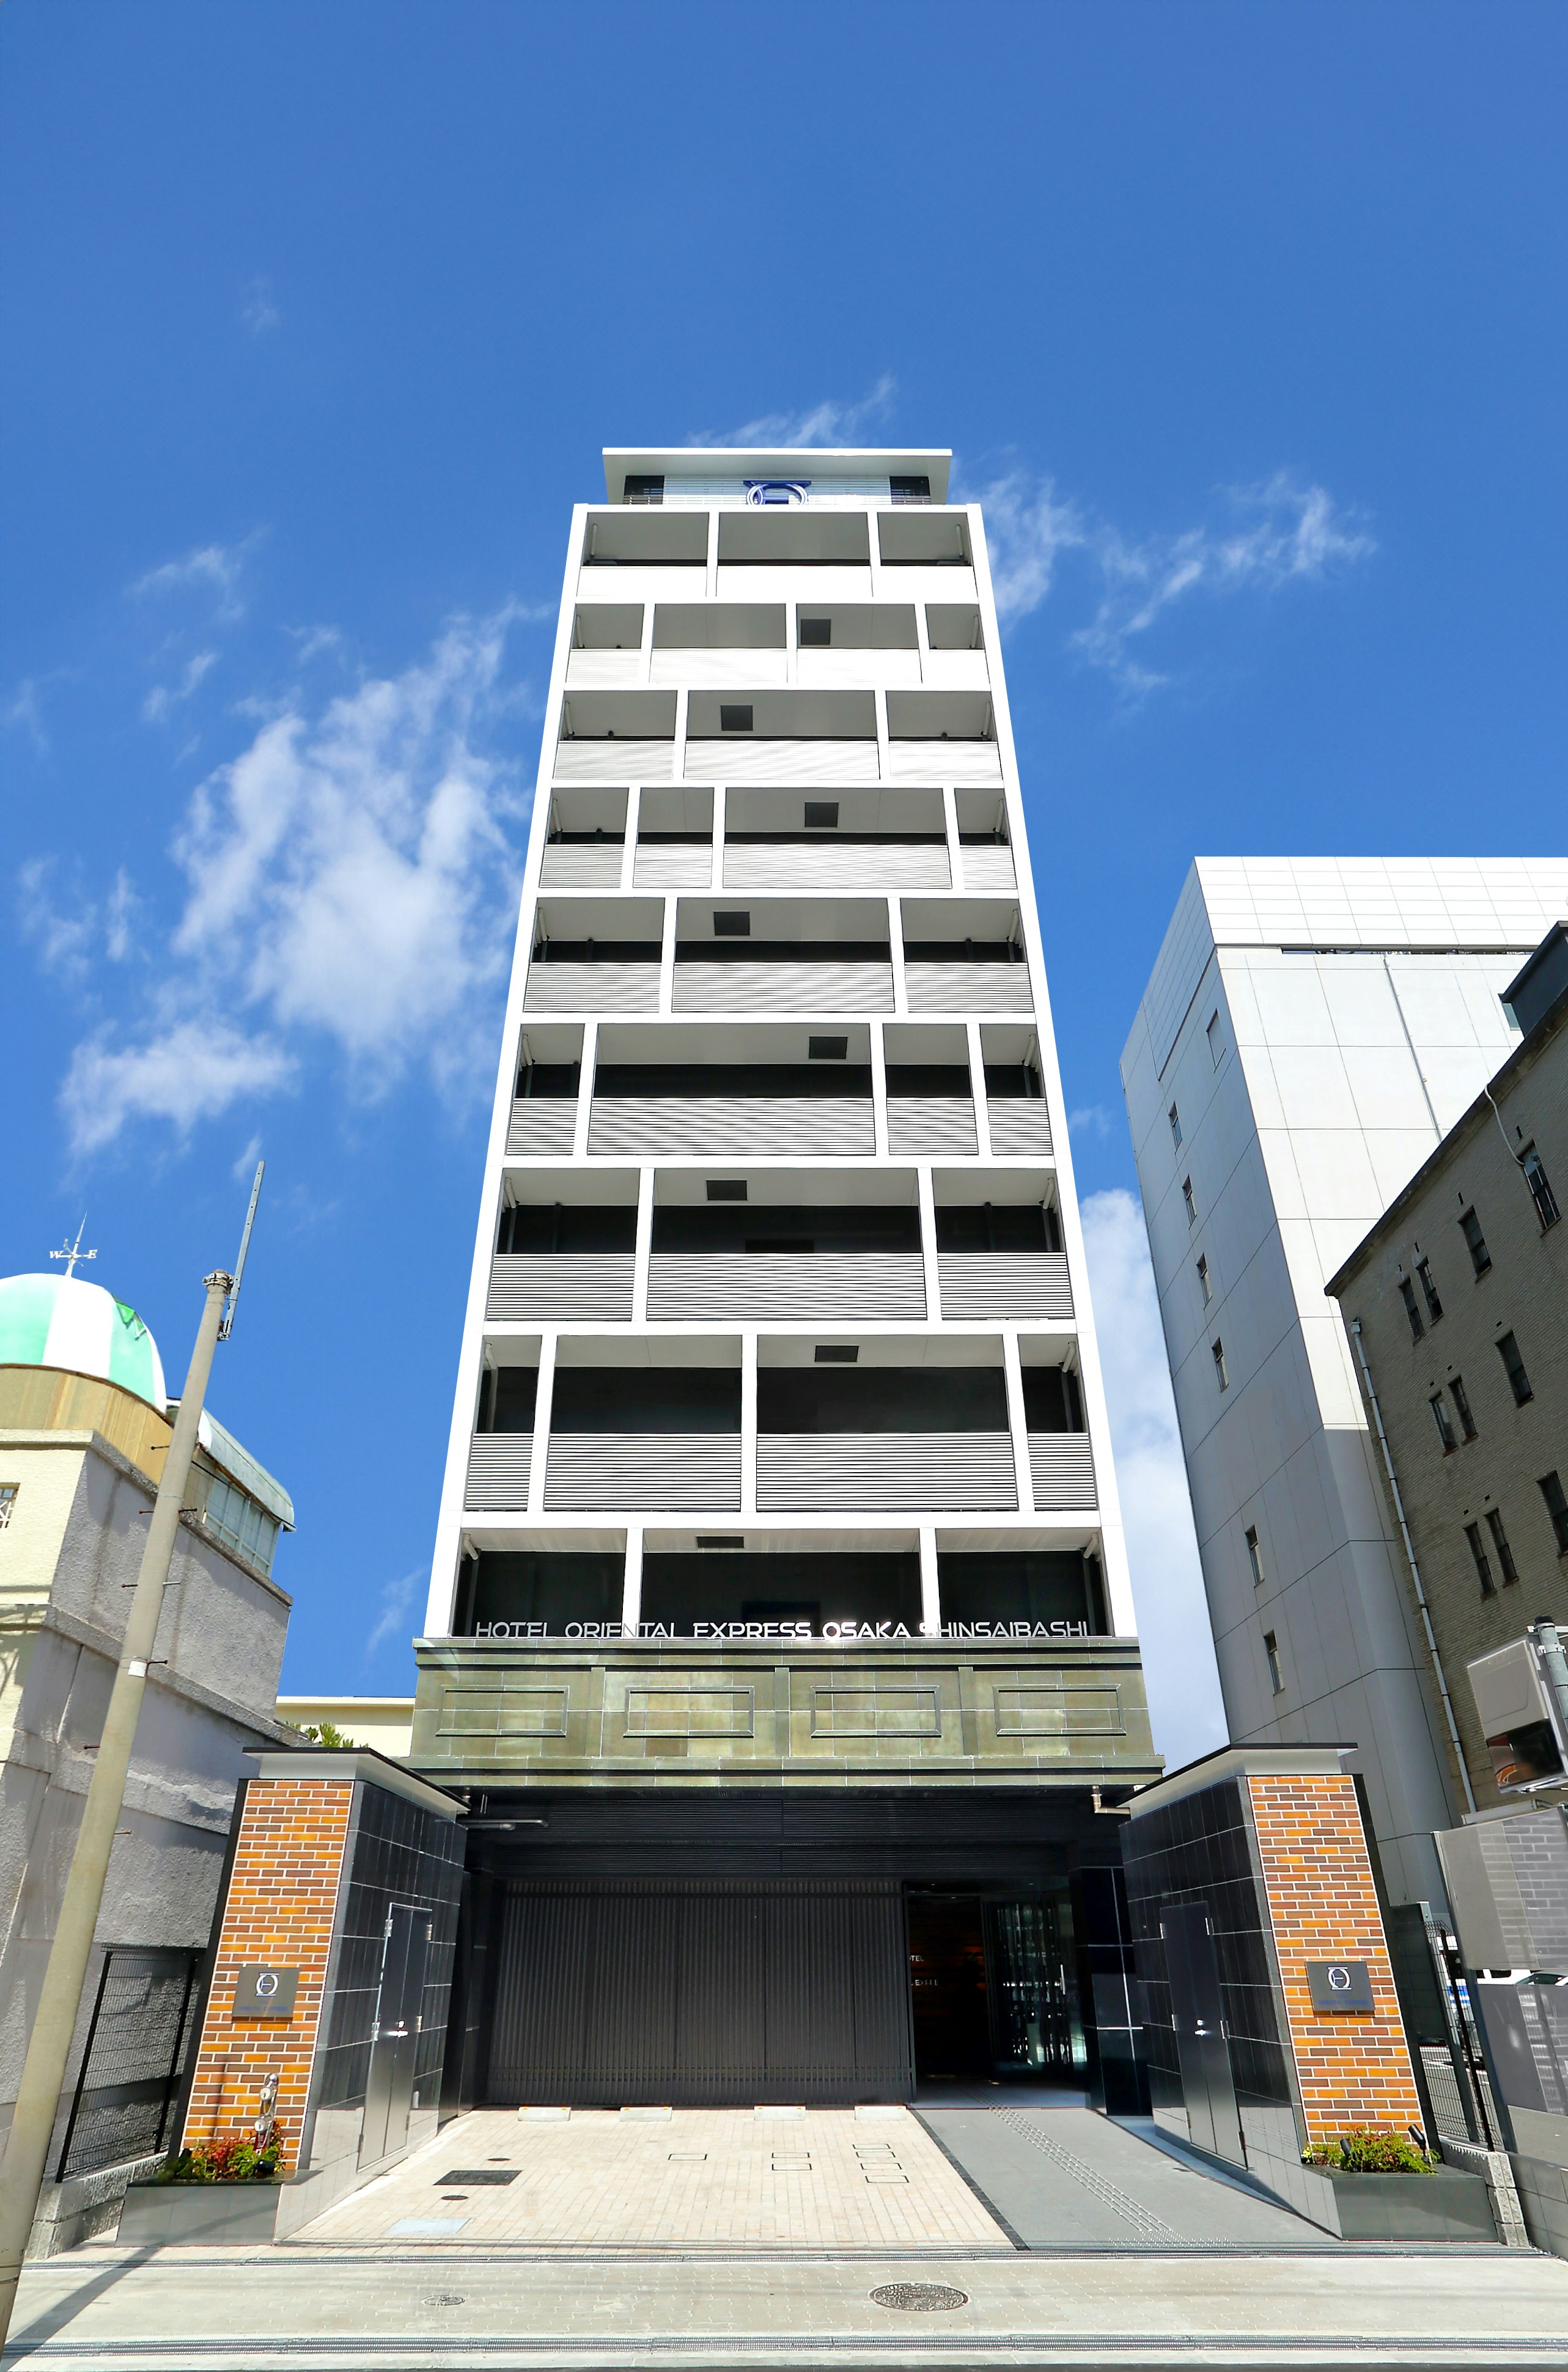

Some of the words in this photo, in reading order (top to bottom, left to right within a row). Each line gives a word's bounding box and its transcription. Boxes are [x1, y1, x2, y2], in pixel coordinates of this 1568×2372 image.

[476, 1622, 547, 1637] HOTEL
[565, 1622, 674, 1638] ORIENTAL
[693, 1622, 812, 1638] EXPRESS
[822, 1621, 911, 1639] OSAKA
[919, 1621, 1088, 1638] SHINSAIBASHI
